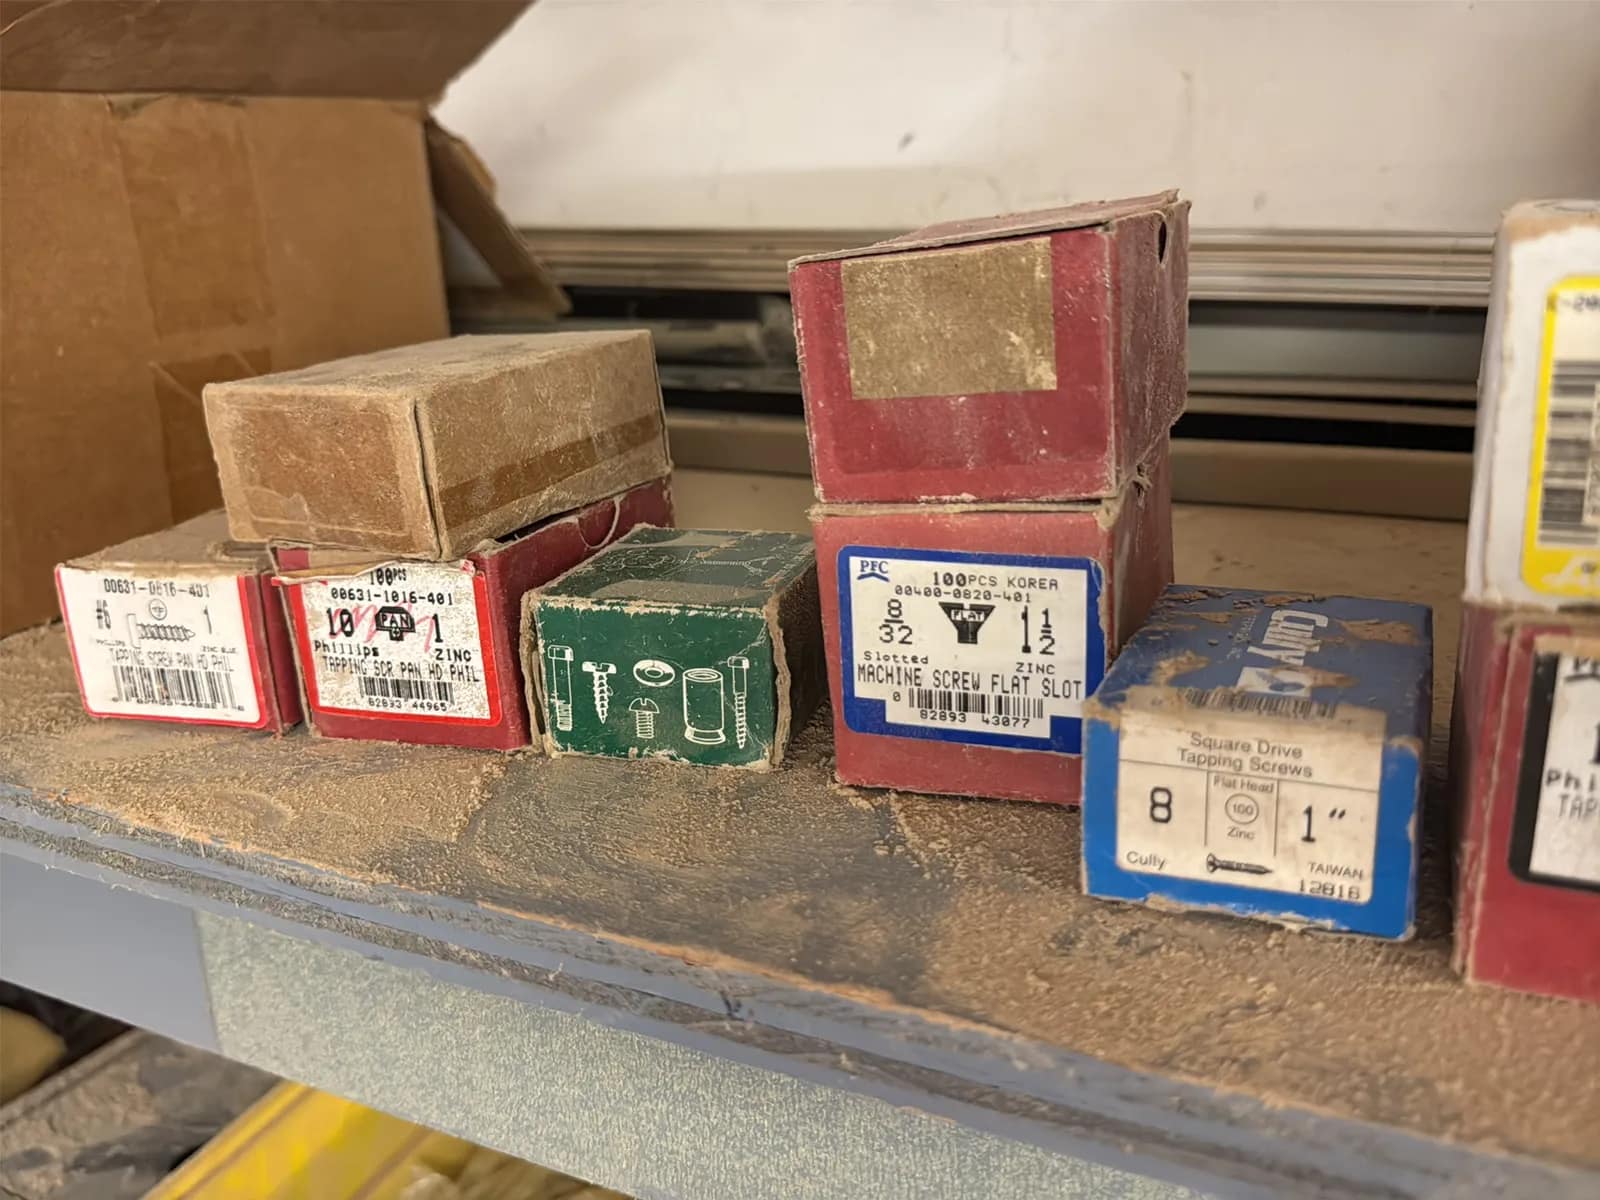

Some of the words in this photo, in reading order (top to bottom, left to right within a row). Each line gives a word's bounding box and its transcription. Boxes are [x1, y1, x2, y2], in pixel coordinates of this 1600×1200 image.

[860, 560, 889, 574] PFC
[1008, 576, 1059, 591] KOREA
[331, 587, 453, 606] 00631-1016-401
[895, 585, 1032, 604] 00400-0820-401
[326, 607, 355, 638] 10
[381, 614, 410, 628] PAN
[951, 609, 985, 622] FLAT
[432, 613, 444, 643] 1
[879, 623, 913, 645] 32
[435, 648, 472, 662] ZINC
[863, 650, 929, 665] Slotted
[322, 655, 368, 677] TAPPING
[374, 661, 395, 677] SCR
[400, 663, 422, 679] PAN
[429, 665, 443, 680] HD
[450, 666, 480, 682] PHIL
[1016, 662, 1056, 675] ZINC
[857, 663, 922, 687] MACHINE
[932, 669, 981, 691] SCREW
[991, 674, 1030, 696] FLAT
[1041, 679, 1082, 700] SLOT
[919, 708, 967, 724] 82893
[982, 716, 1031, 729] 43077
[1190, 731, 1251, 756] Square
[1256, 738, 1303, 759] Drive
[1178, 747, 1243, 772] Tapping
[1249, 756, 1313, 778] Screws
[1213, 774, 1237, 789] Flat
[1240, 778, 1274, 795] Head
[1149, 787, 1173, 824] 8
[1232, 802, 1255, 816] 100
[1226, 825, 1255, 841] Zinc
[1126, 850, 1166, 871] Cully
[1307, 861, 1364, 881] TAIWAN
